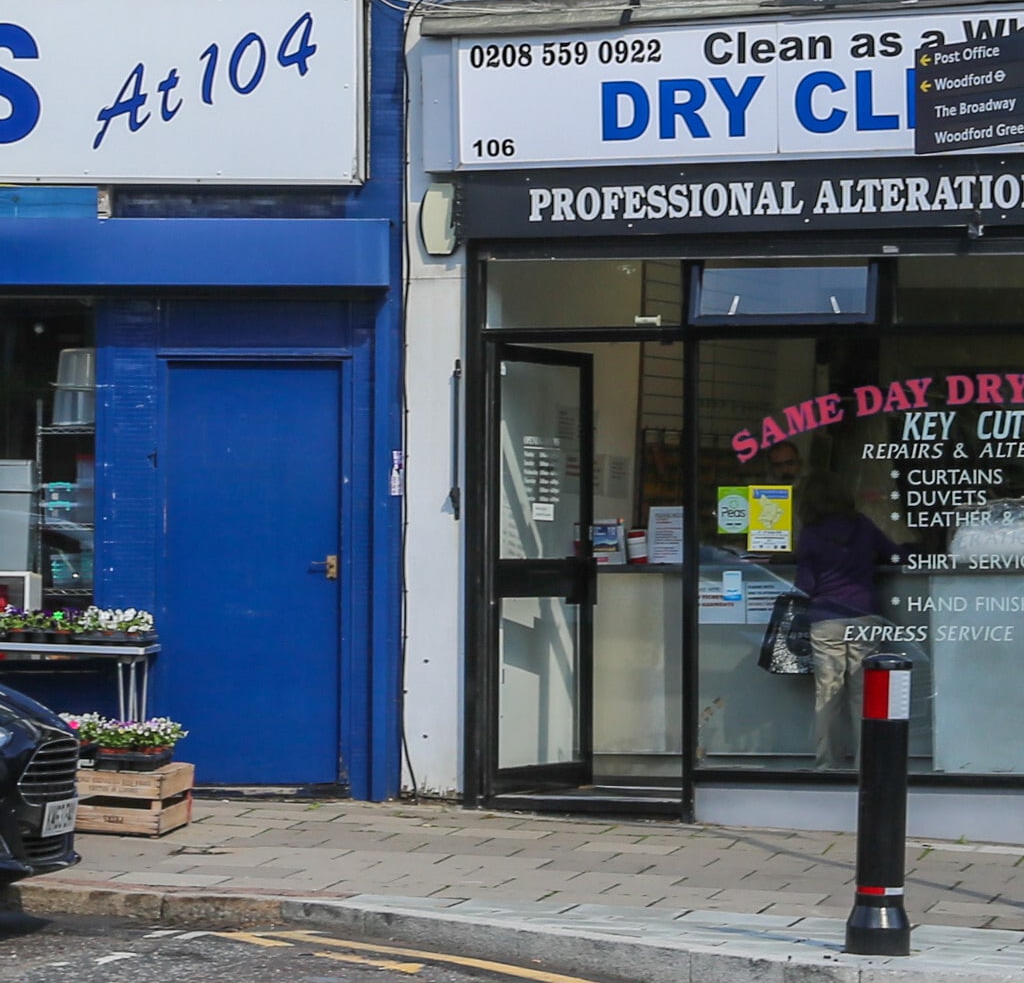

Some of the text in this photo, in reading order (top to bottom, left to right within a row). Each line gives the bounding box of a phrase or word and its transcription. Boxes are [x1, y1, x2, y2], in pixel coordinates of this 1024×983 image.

[469, 38, 662, 68] 0208 559 0922
[703, 31, 834, 65] Clean
[850, 31, 904, 59] as
[933, 44, 1000, 66] Post Office
[93, 62, 183, 150] At
[199, 11, 317, 105] 104
[934, 72, 993, 91] Woodford
[601, 75, 765, 142] DRY
[935, 96, 1017, 118] The Broadway
[935, 126, 993, 145] Woodford
[472, 138, 515, 158] 106
[528, 180, 803, 223] PROFESSIONAL
[731, 393, 844, 463] SAME
[853, 378, 932, 417] DAY
[902, 411, 956, 441] KEY
[862, 443, 944, 459] REPAIRS
[953, 443, 968, 459] &
[907, 468, 1003, 486] CURTAINS
[907, 490, 987, 507] DUVETS
[907, 511, 991, 528] LEATHER
[1001, 511, 1016, 526] &
[908, 554, 957, 570] SHIRT
[908, 596, 967, 612] HAND
[844, 625, 928, 642] EXPRESS
[935, 625, 1014, 642] SERVICE
